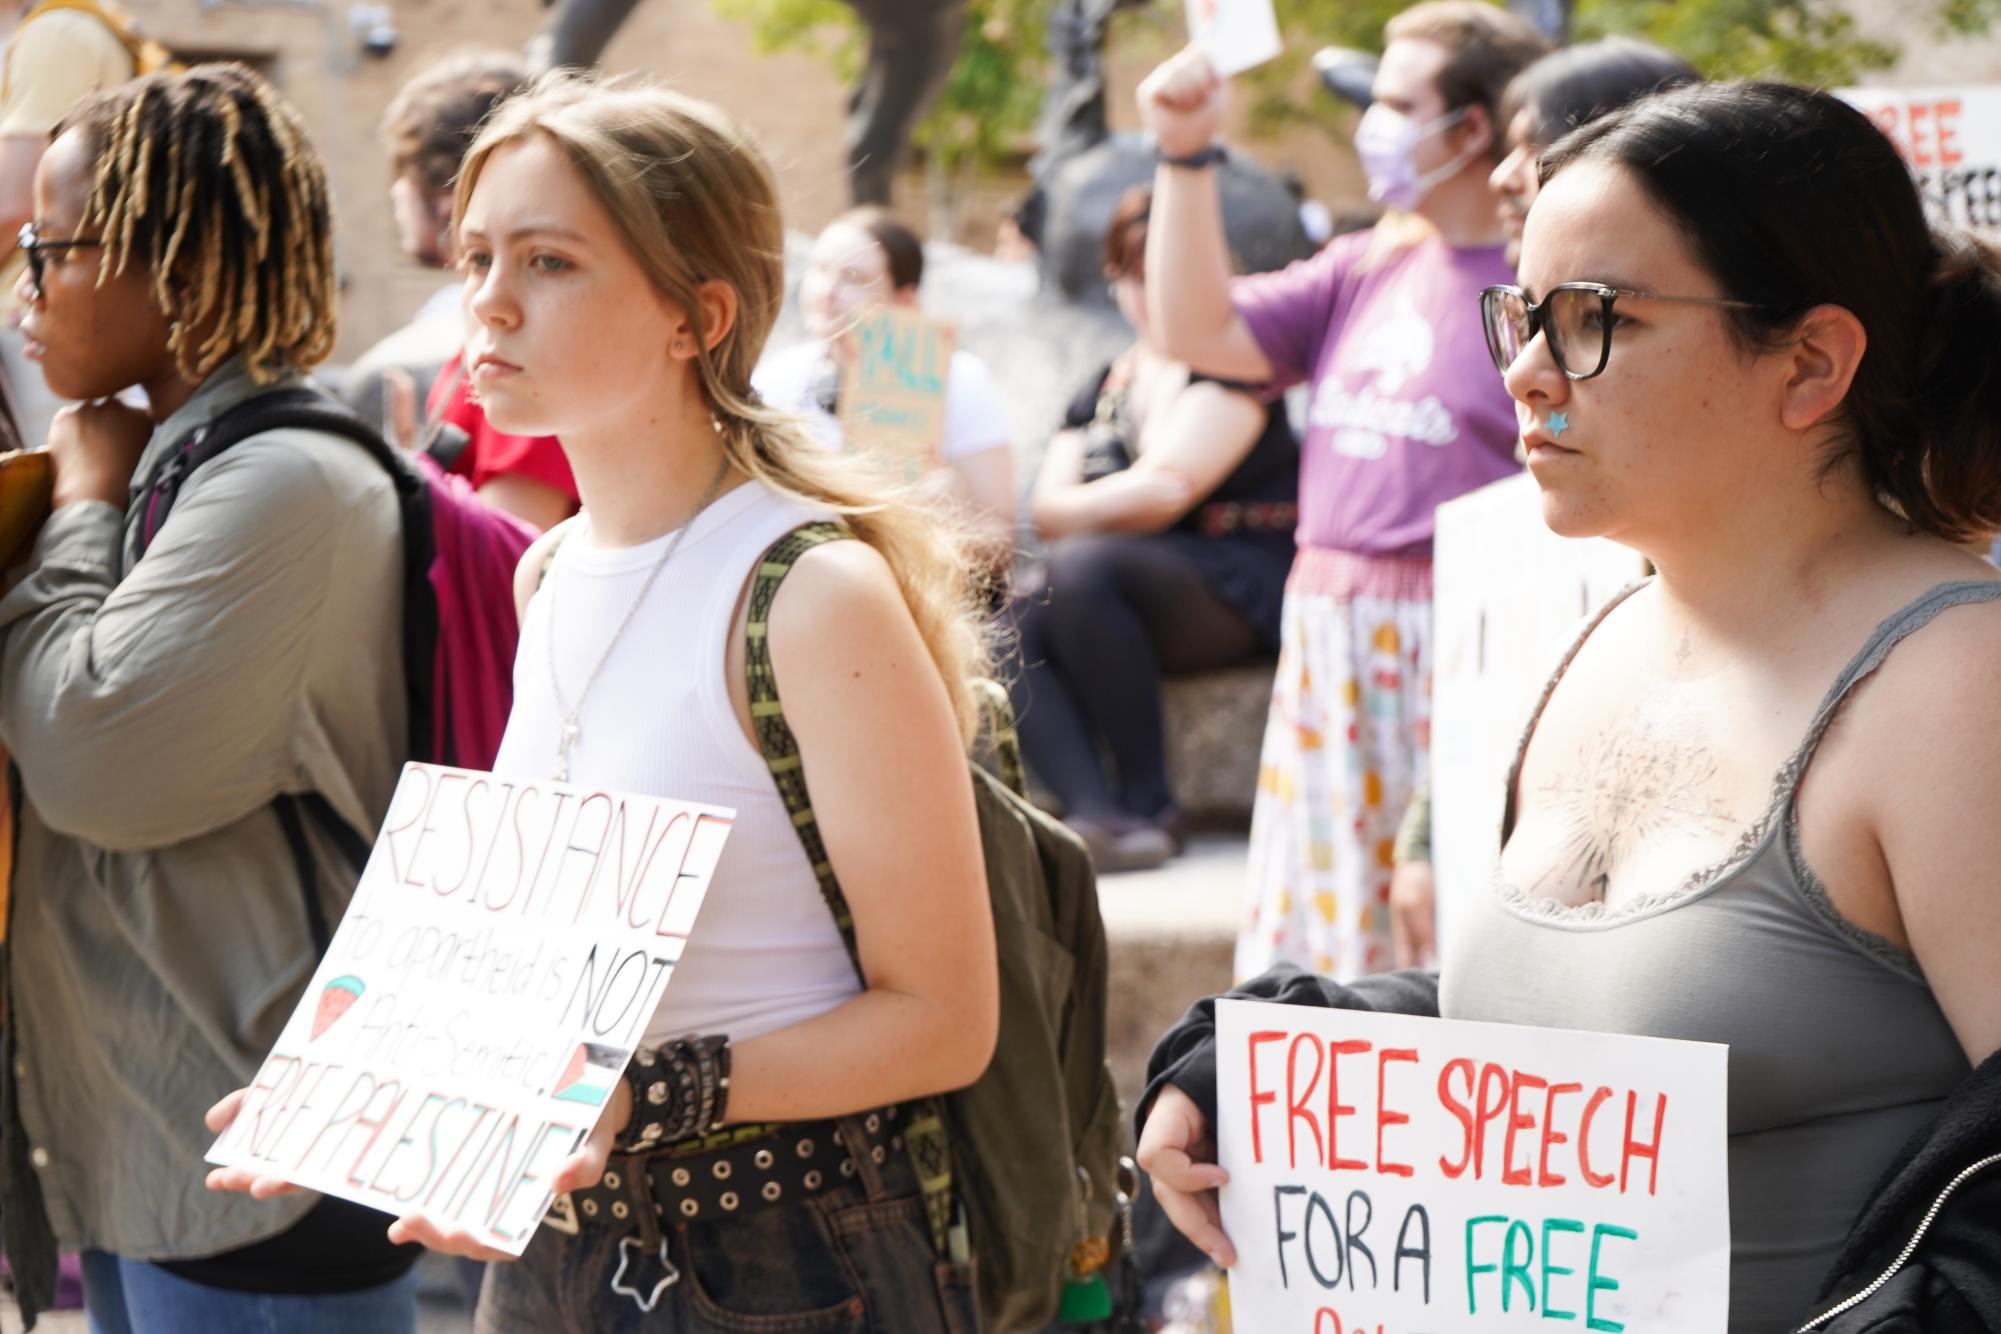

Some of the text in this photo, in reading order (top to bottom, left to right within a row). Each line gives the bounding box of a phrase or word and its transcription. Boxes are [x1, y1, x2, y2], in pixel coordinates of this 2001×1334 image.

[1866, 99, 1963, 167] REE
[387, 766, 735, 938] RESISTANCE
[338, 892, 679, 1044] to apartheid is NOT
[218, 1052, 344, 1163] FREE
[1248, 1030, 1668, 1197] FREE SPEECH
[1274, 1184, 1639, 1333] FOR A FREE
